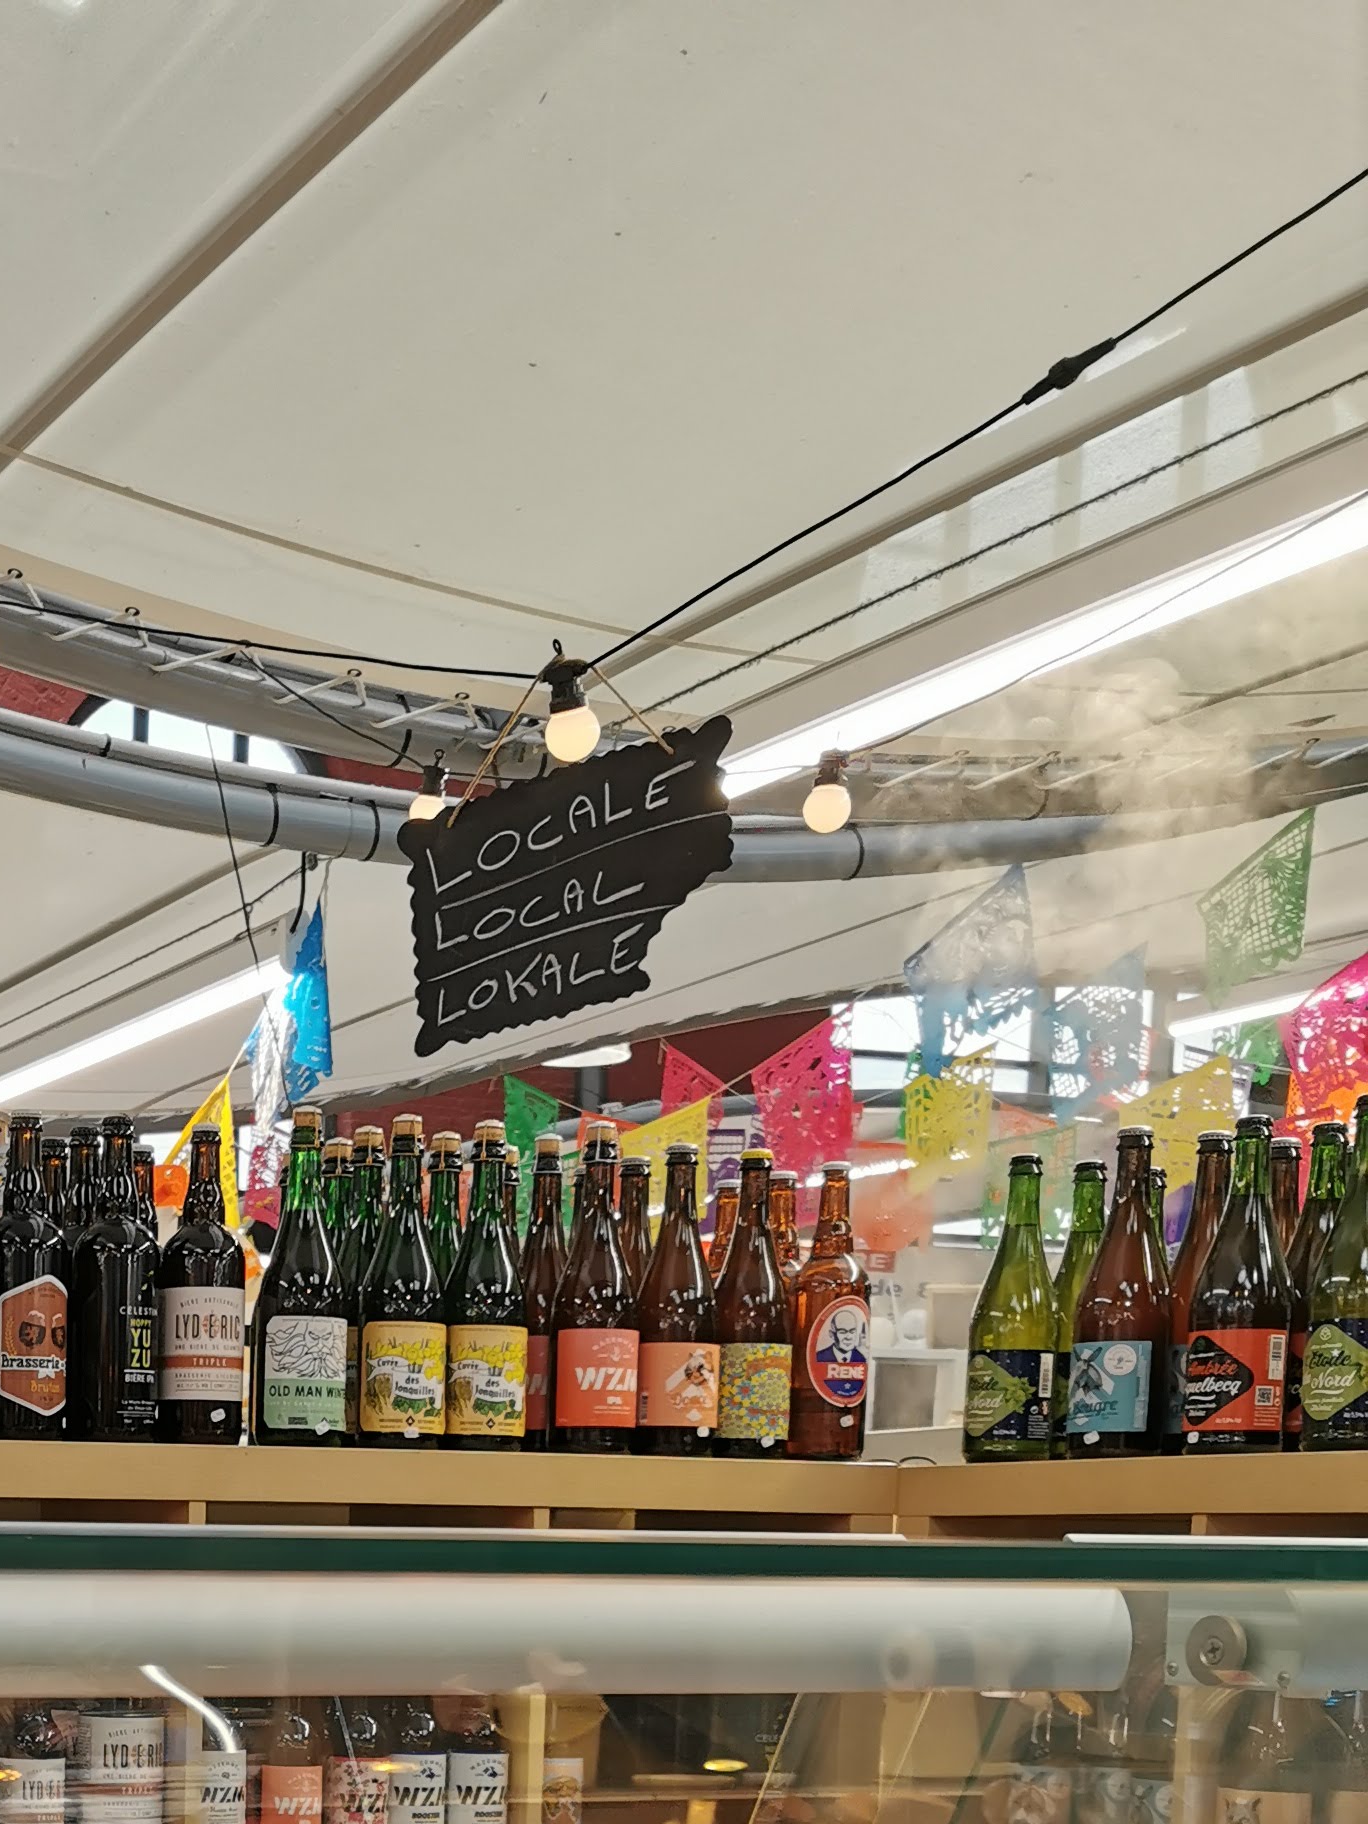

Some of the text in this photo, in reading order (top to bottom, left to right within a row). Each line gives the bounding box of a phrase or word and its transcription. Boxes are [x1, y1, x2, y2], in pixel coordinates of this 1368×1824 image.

[426, 761, 695, 894] LOCALE
[435, 871, 644, 950] LOCAL
[437, 923, 644, 1026] LOKALE
[131, 1328, 151, 1348] YU
[131, 1349, 151, 1368] ZU
[193, 1357, 227, 1367] TRIPLE
[404, 1375, 420, 1385] des
[827, 1363, 865, 1380] RENÉ
[1311, 1368, 1356, 1389] Nord
[269, 1385, 323, 1398] OLD MAN
[485, 1378, 500, 1387] des
